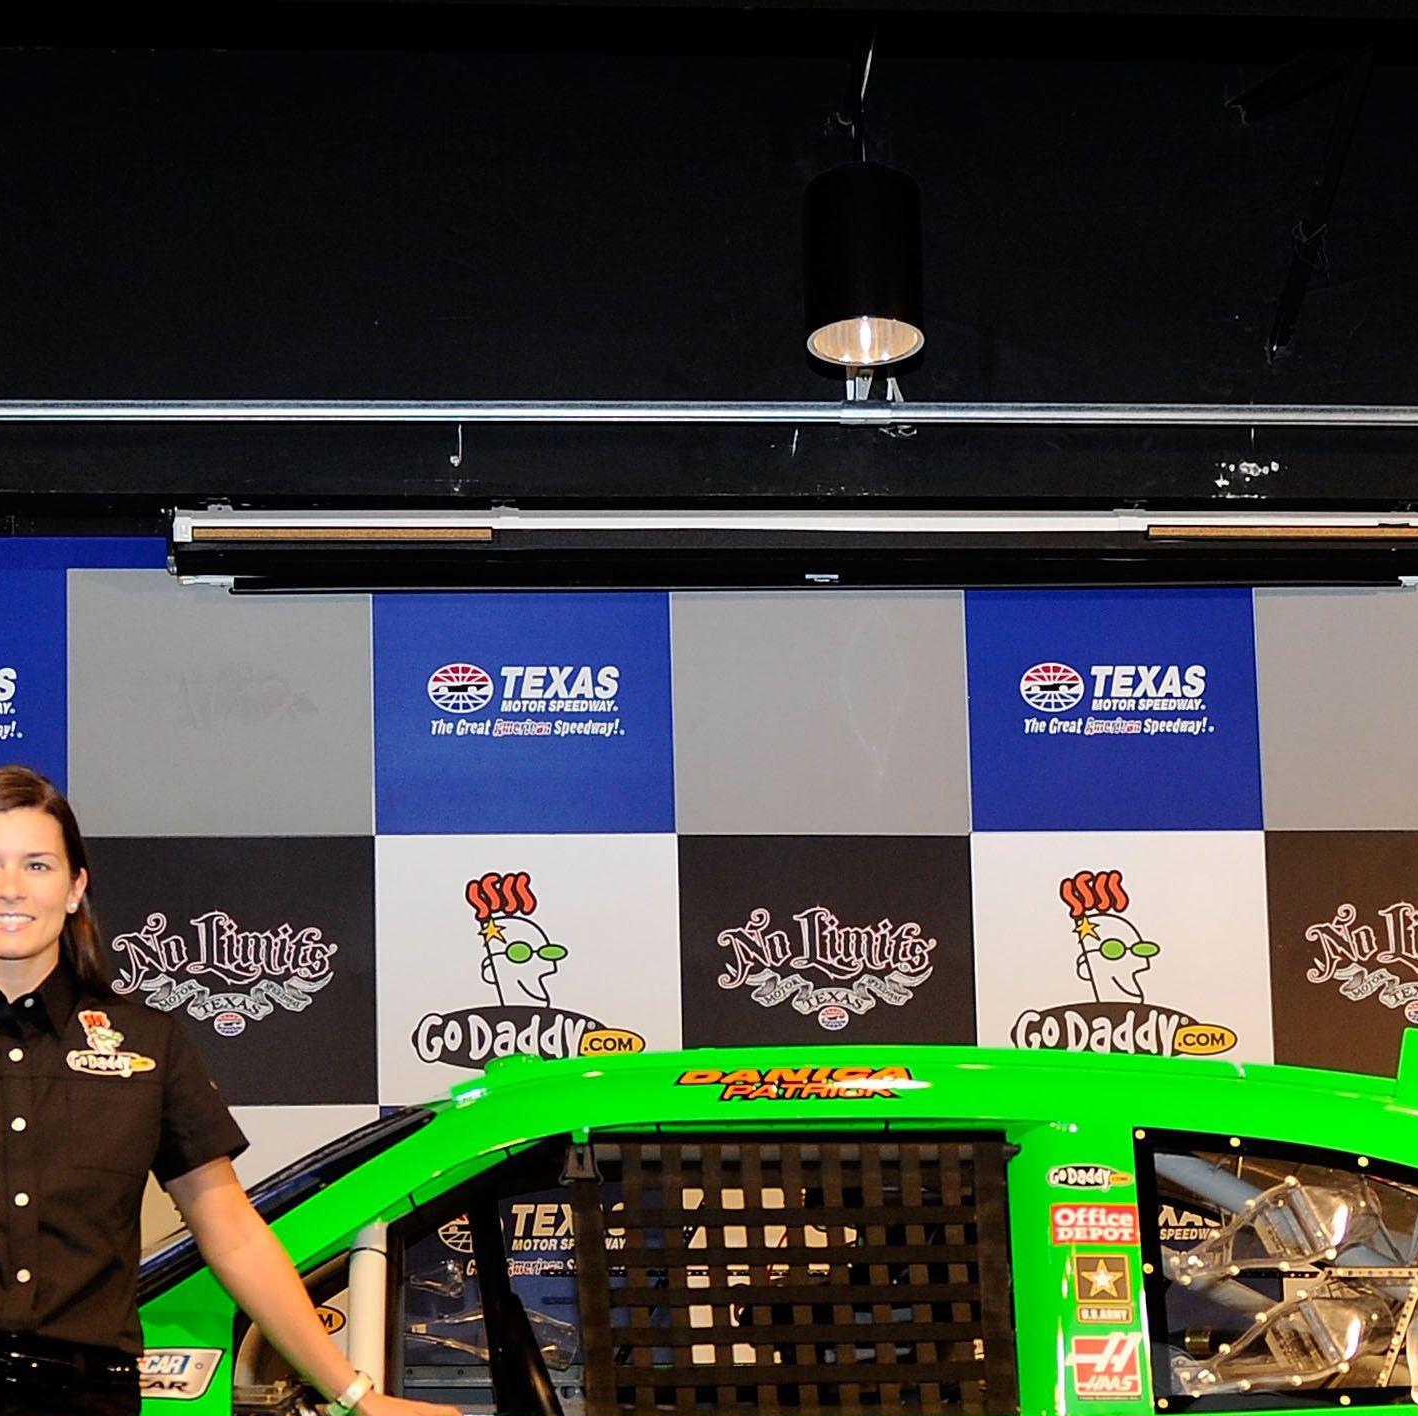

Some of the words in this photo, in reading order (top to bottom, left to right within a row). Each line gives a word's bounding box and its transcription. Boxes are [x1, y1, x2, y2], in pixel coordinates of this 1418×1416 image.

[501, 666, 620, 699] TEXAS
[1090, 665, 1206, 698] TEXAS
[501, 700, 547, 712] MOTOR
[1092, 699, 1136, 711] MOTOR
[431, 719, 453, 735] The
[456, 719, 490, 736] Great
[1024, 718, 1046, 734] The
[1049, 718, 1081, 734] Great
[111, 912, 188, 994] No
[186, 910, 338, 985] Limits
[717, 908, 791, 989] No
[790, 904, 937, 980] Limits
[1305, 903, 1378, 983] No
[198, 997, 261, 1017] TEXAS
[801, 991, 863, 1010] TEXAS
[417, 1015, 462, 1061] Go
[467, 1014, 586, 1061] Daddy
[584, 1037, 633, 1051] .COM
[1016, 1010, 1060, 1049] Go
[1064, 1009, 1179, 1057] Daddy
[1178, 1032, 1226, 1047] .COM
[677, 1066, 913, 1085] DANICA
[1067, 1167, 1111, 1192] Daddy
[1055, 1207, 1134, 1227] Office
[1056, 1227, 1135, 1241] DEPOT
